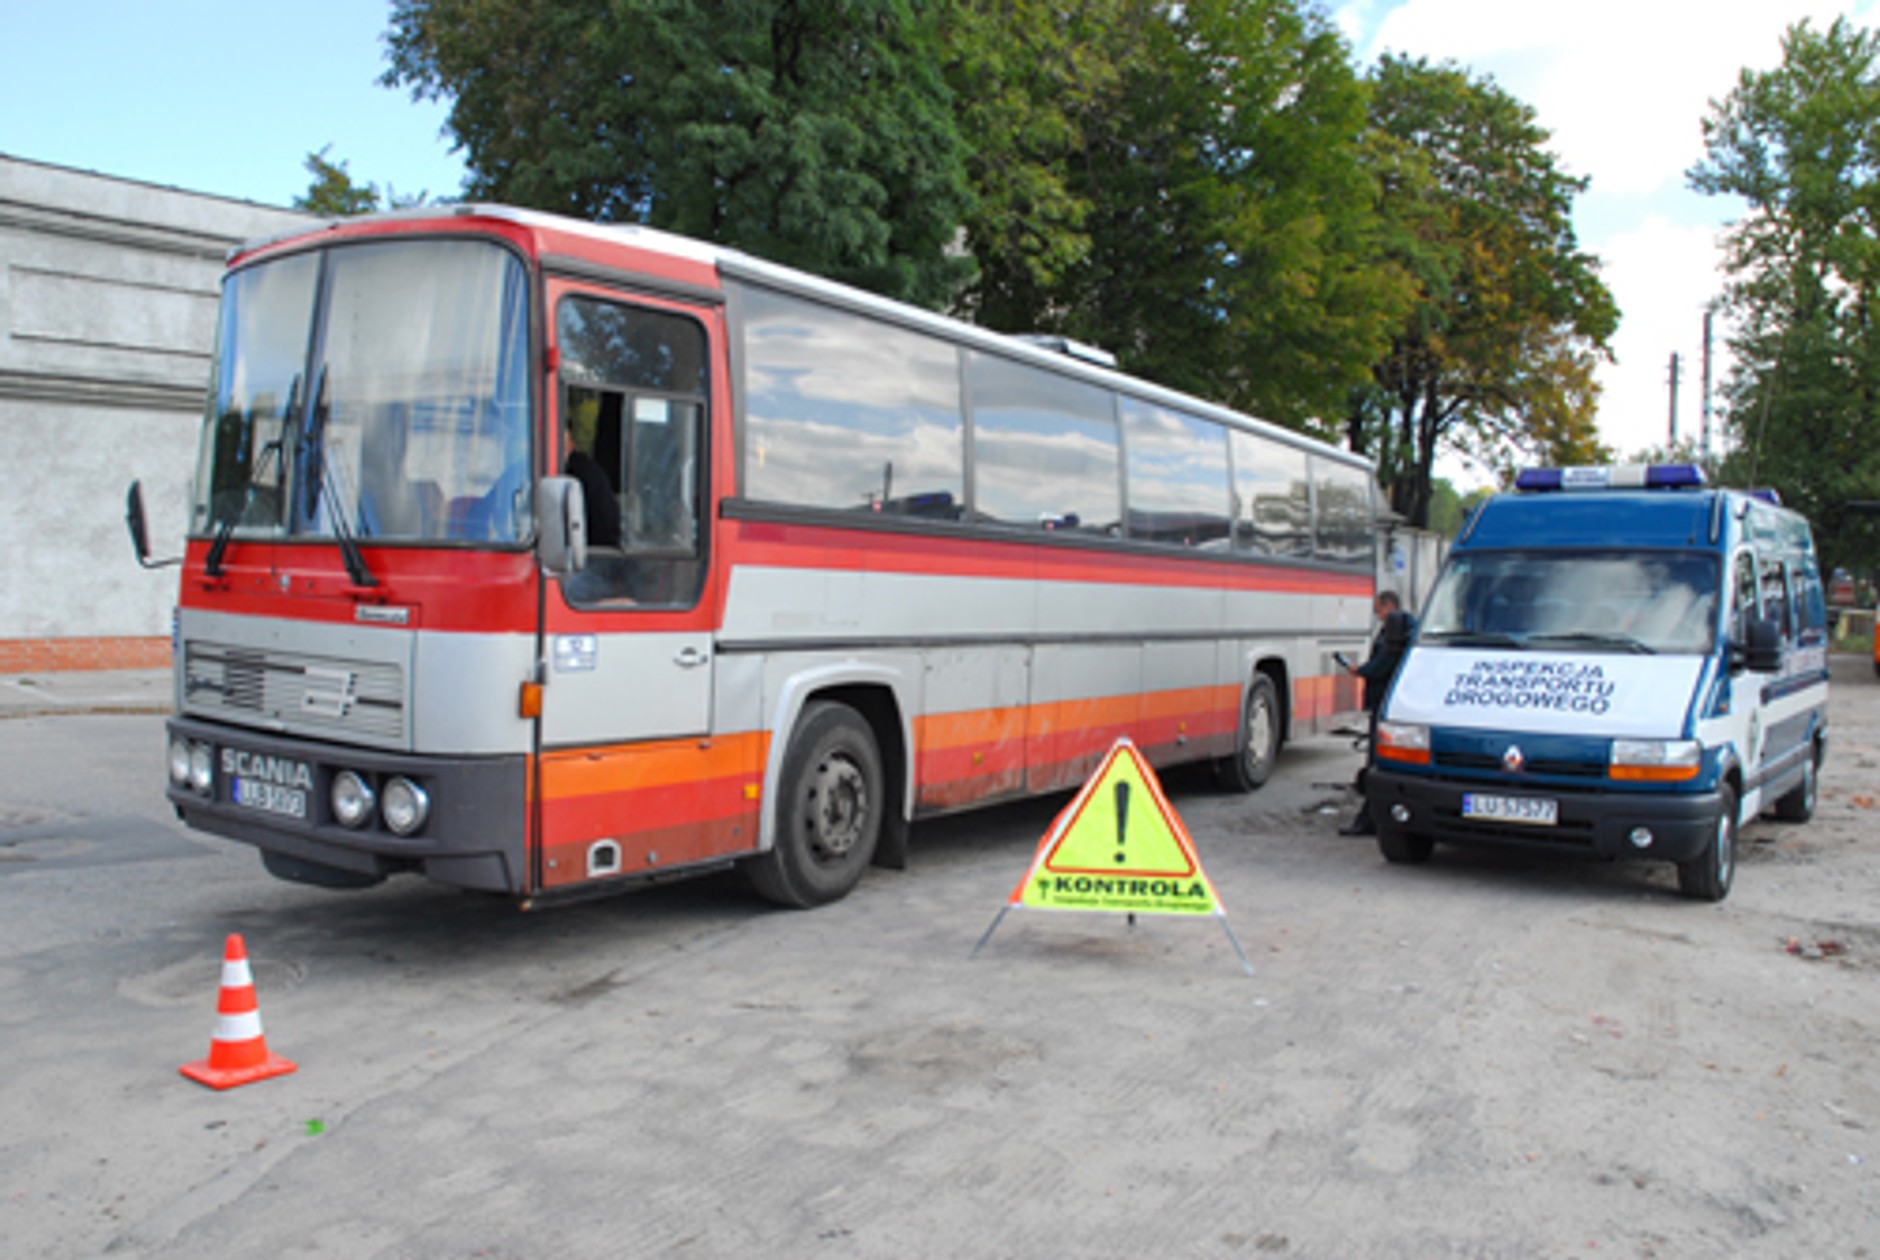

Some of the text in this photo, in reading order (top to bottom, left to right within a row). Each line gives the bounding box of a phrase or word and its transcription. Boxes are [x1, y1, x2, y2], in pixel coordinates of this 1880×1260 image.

[1472, 661, 1604, 678] INSPEKCJA
[1455, 673, 1615, 697] TRANSPORTU
[1443, 689, 1611, 715] DROGOWEGO
[221, 748, 314, 791] SCANIA
[1055, 877, 1205, 899] KONTROLA
